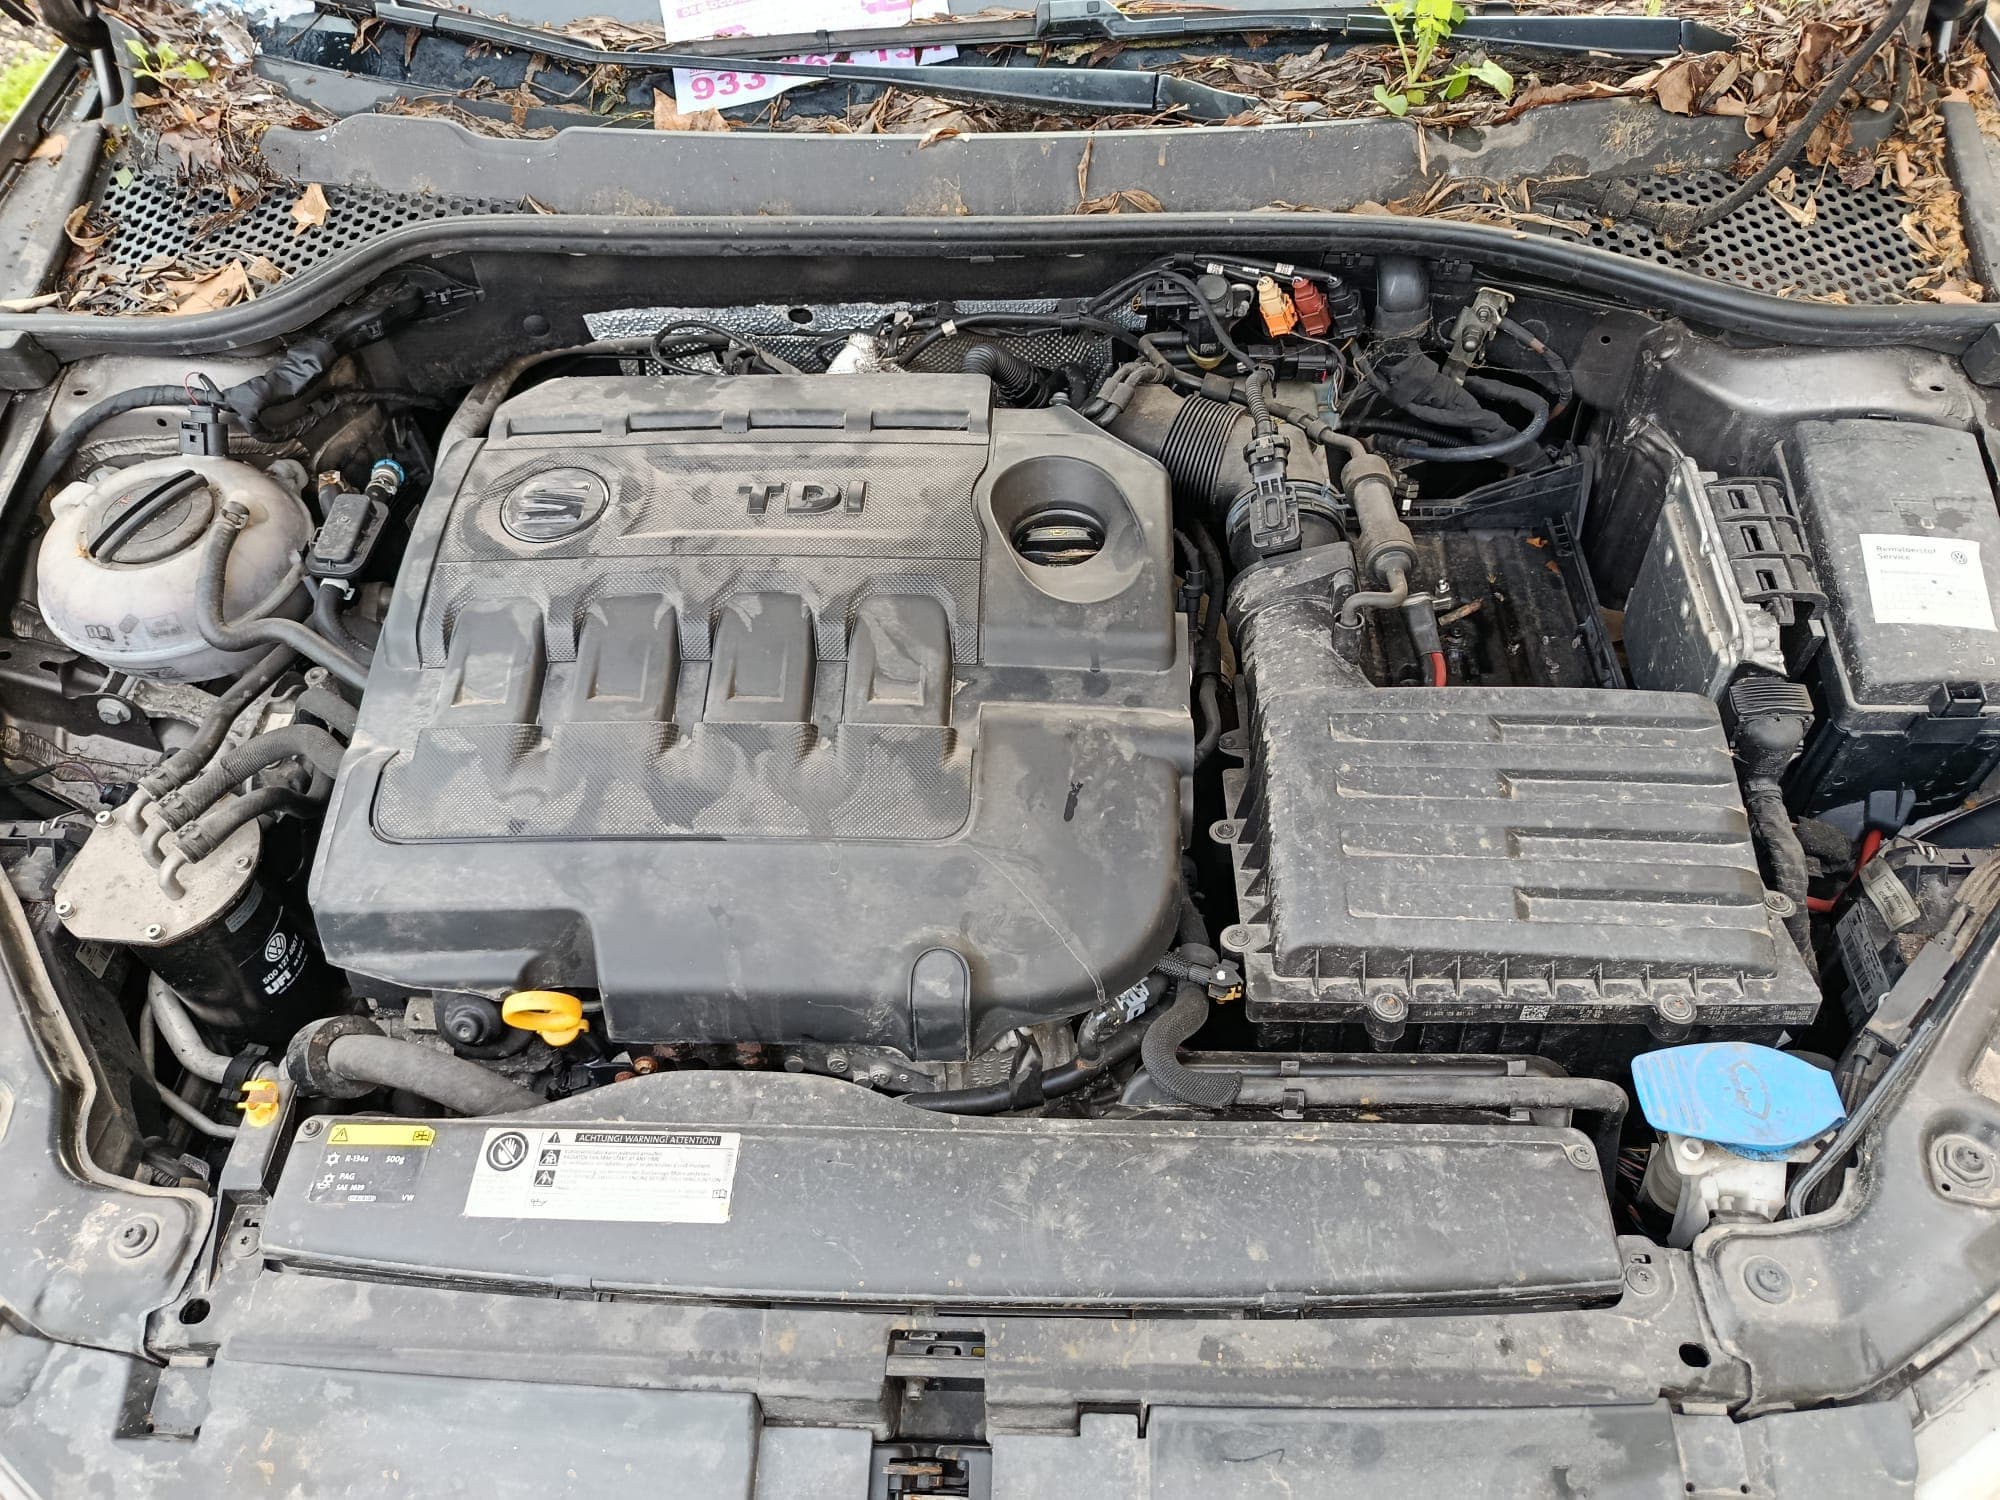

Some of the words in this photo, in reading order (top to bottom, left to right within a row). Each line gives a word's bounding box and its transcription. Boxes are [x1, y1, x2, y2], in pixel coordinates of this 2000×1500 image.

[737, 481, 869, 516] TDI
[264, 969, 292, 995] UFI
[578, 1134, 624, 1143] ACHTUNG!
[624, 1135, 669, 1144] WARNING!
[669, 1136, 719, 1145] ATTENTION!
[345, 1154, 369, 1163] R-134a
[385, 1155, 405, 1165] 500g
[339, 1172, 356, 1181] PAG
[401, 1194, 415, 1202] VW
